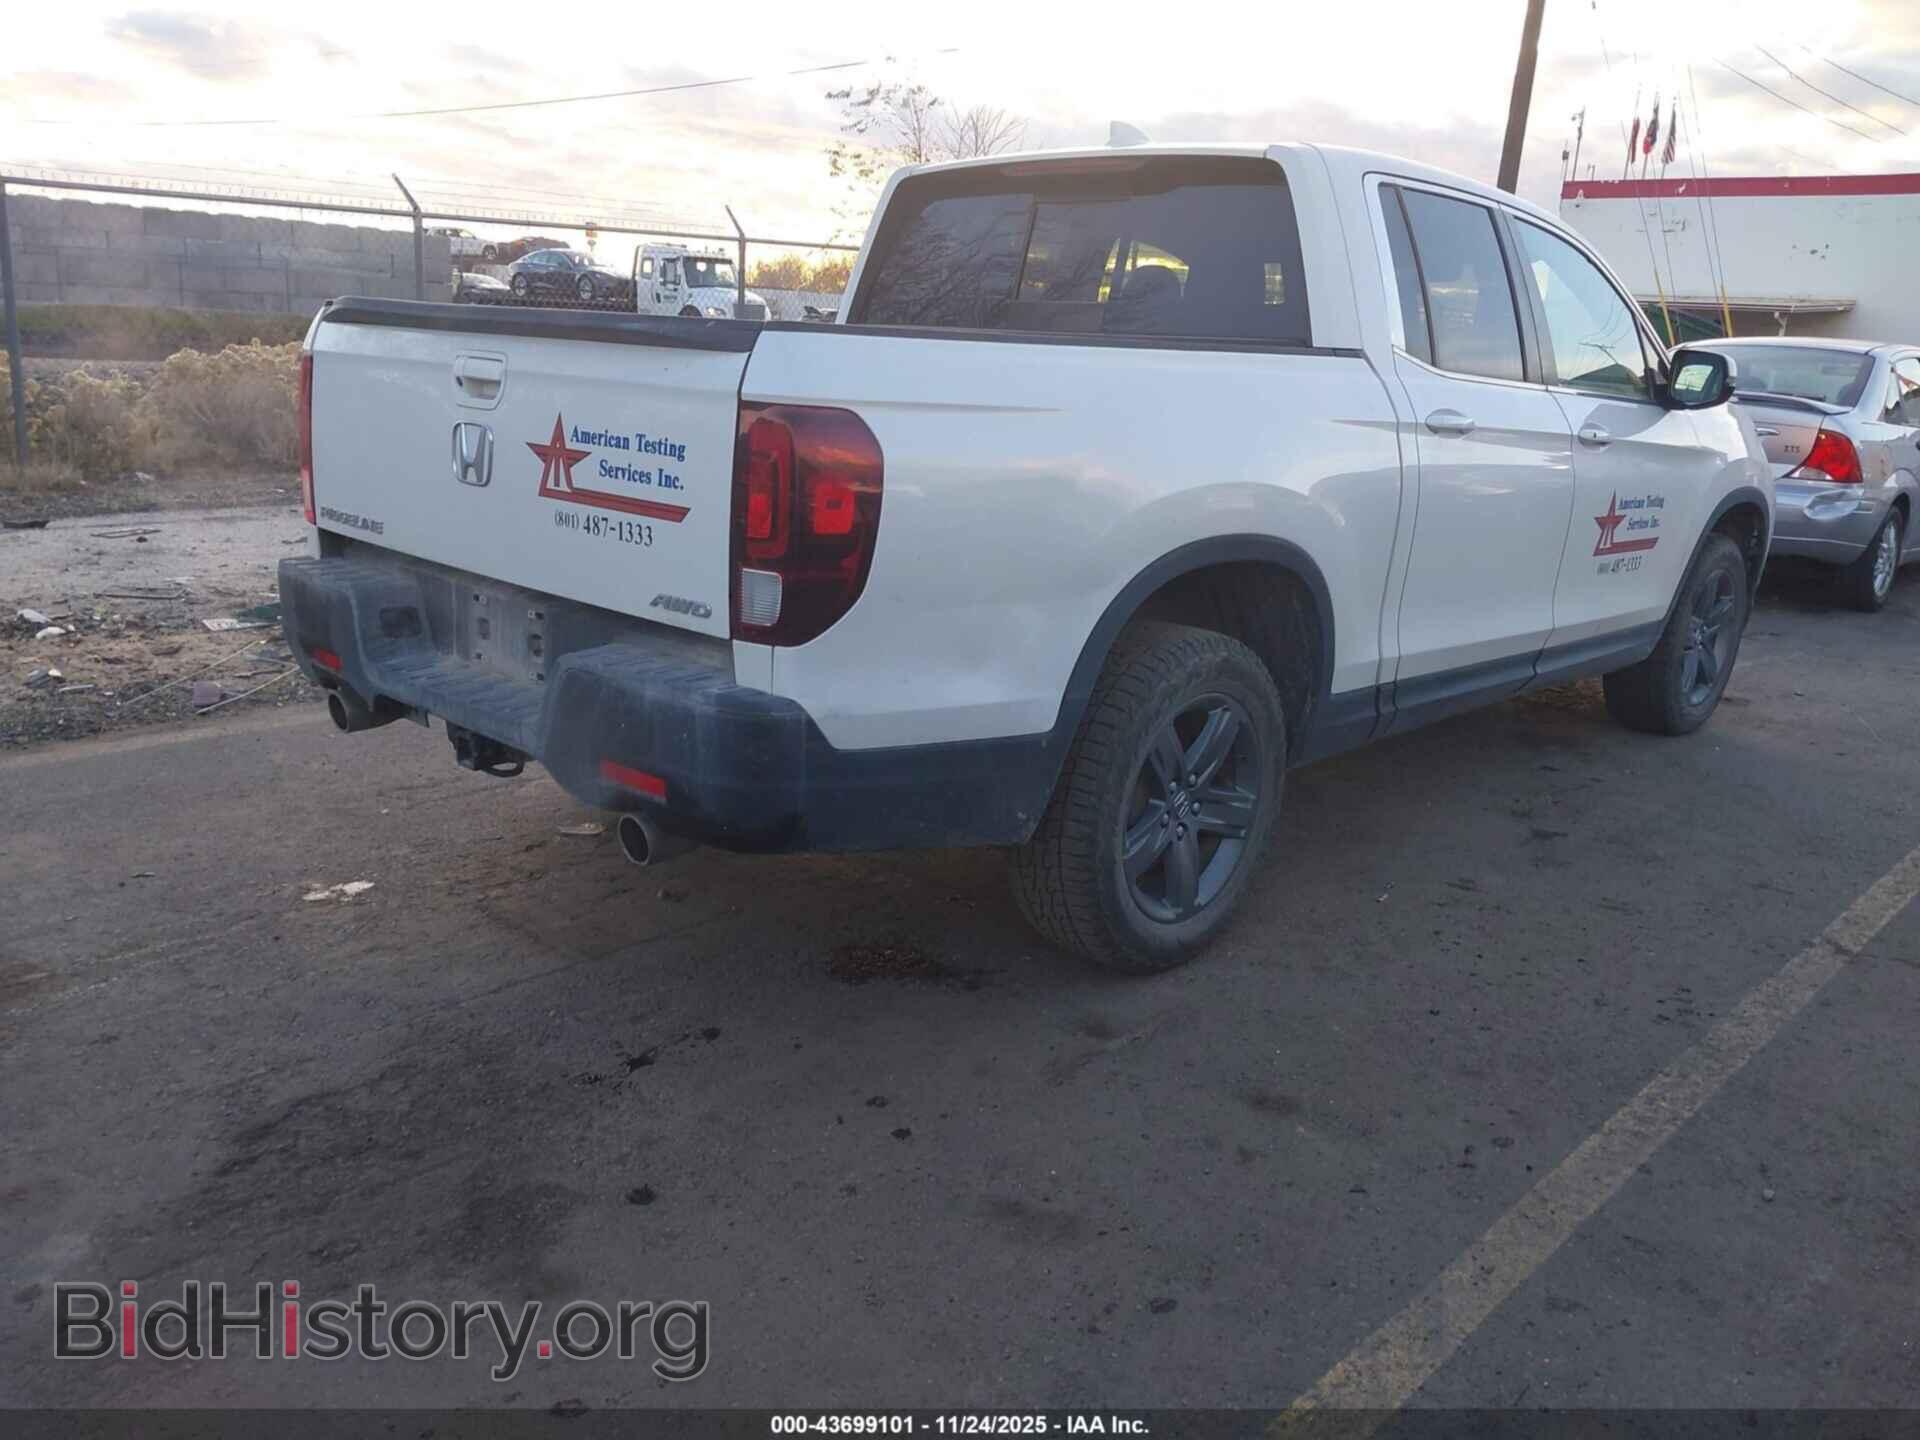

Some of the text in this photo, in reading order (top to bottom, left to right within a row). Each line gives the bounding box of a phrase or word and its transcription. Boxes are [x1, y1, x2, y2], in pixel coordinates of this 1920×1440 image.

[569, 425, 686, 462] American Testing
[599, 458, 684, 490] Services Inc.
[554, 509, 653, 547] (801) 487-1333
[648, 593, 713, 619] AWD
